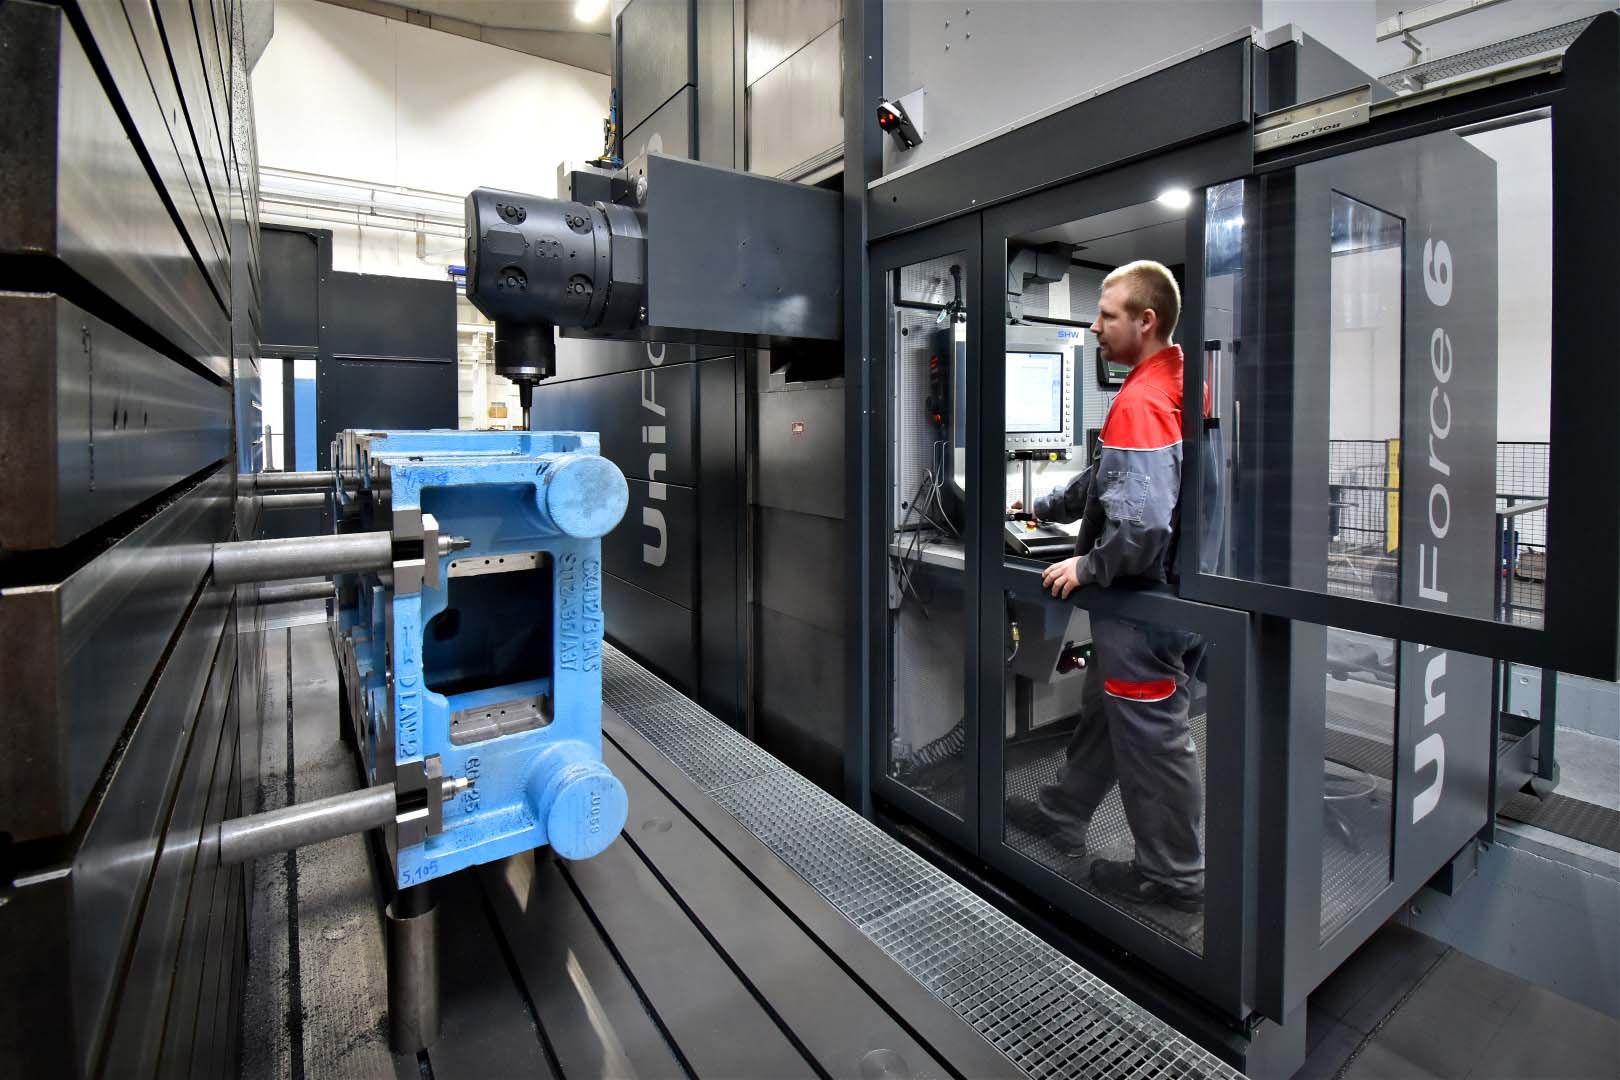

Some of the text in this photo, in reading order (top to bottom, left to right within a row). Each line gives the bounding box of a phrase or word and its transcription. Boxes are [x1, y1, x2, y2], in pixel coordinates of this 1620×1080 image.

[1057, 330, 1080, 339] SHW
[1413, 238, 1453, 824] UnForce 6
